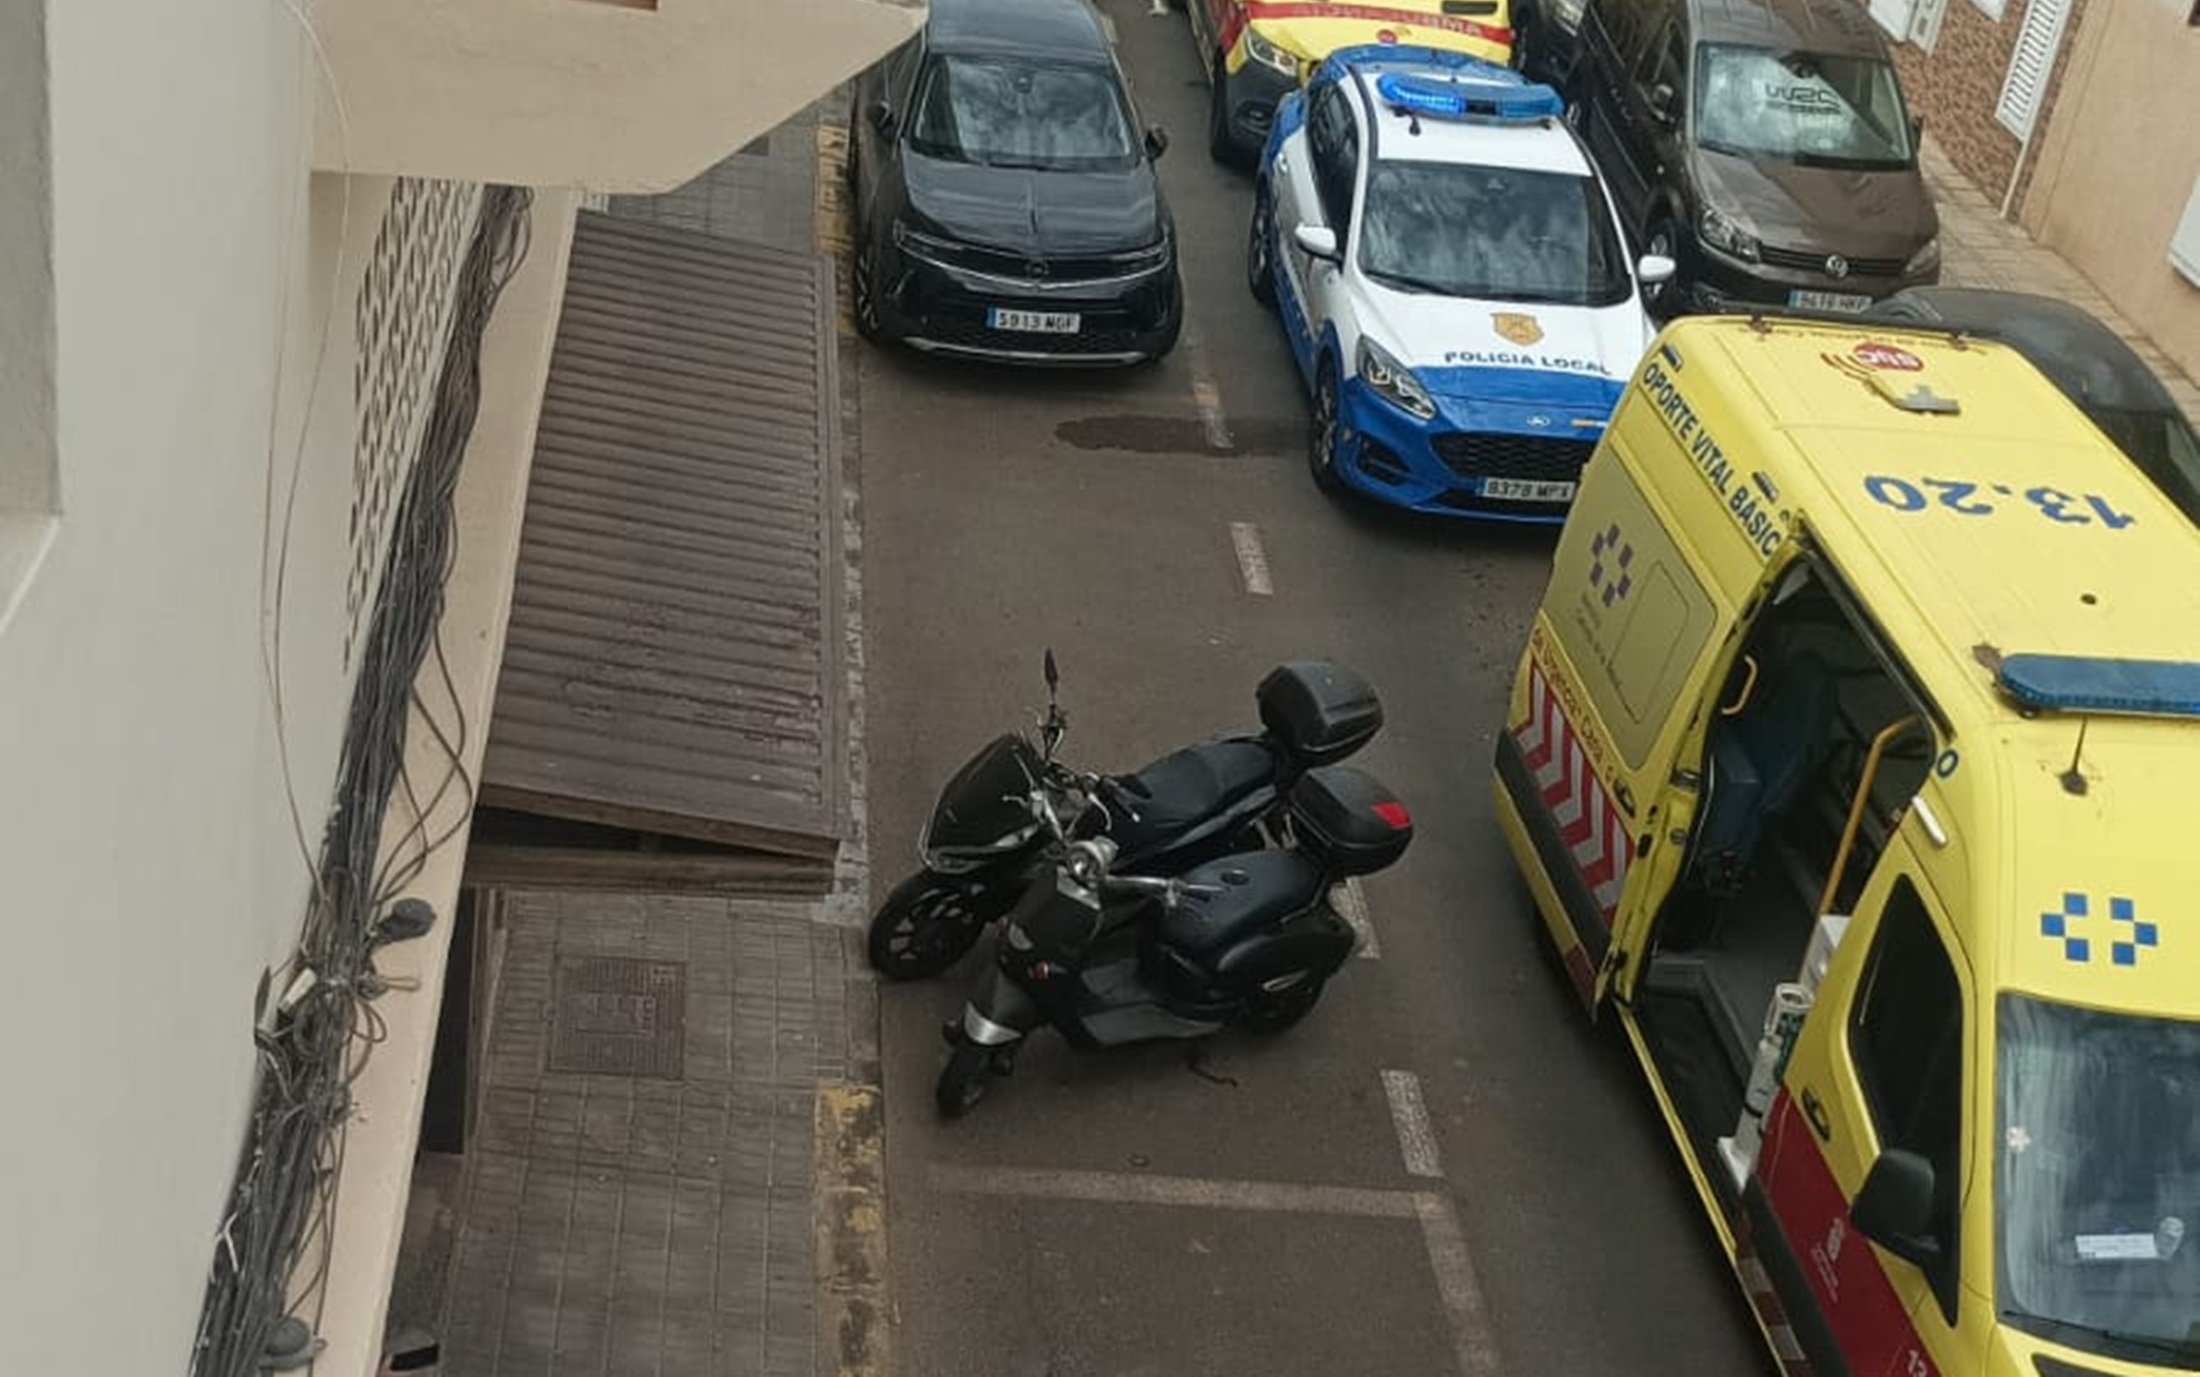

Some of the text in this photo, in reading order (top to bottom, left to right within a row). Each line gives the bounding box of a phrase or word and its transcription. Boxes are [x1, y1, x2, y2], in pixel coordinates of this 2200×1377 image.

[1541, 356, 1612, 376] LOCAL
[1643, 362, 1698, 441] OPORTE
[1691, 429, 1734, 496] VITAL
[1864, 476, 2136, 528] 13.20
[1936, 749, 1959, 779] O
